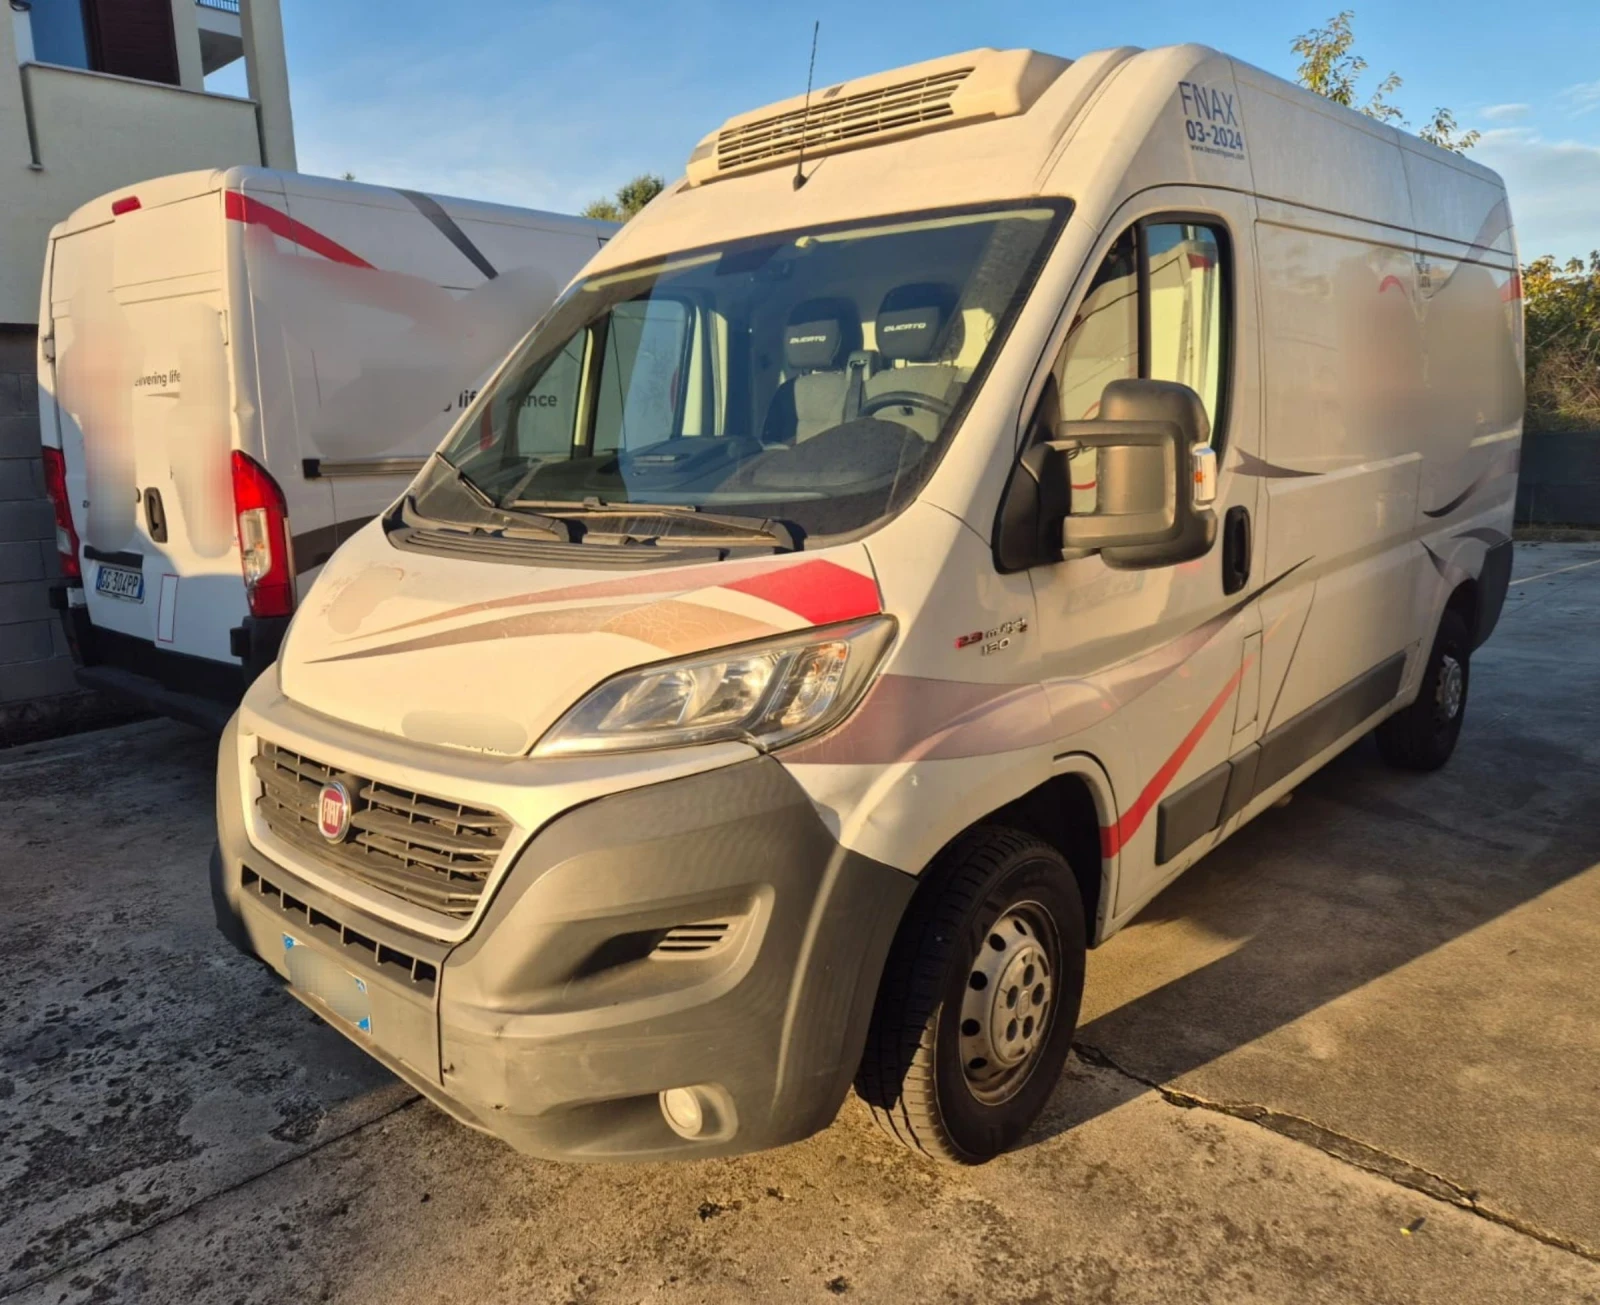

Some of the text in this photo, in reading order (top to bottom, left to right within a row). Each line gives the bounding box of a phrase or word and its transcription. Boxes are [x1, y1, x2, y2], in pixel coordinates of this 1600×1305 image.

[1178, 81, 1238, 128] FNAX
[1186, 119, 1244, 151] 03-2024
[458, 389, 478, 408] lif
[322, 797, 342, 827] FIAT
